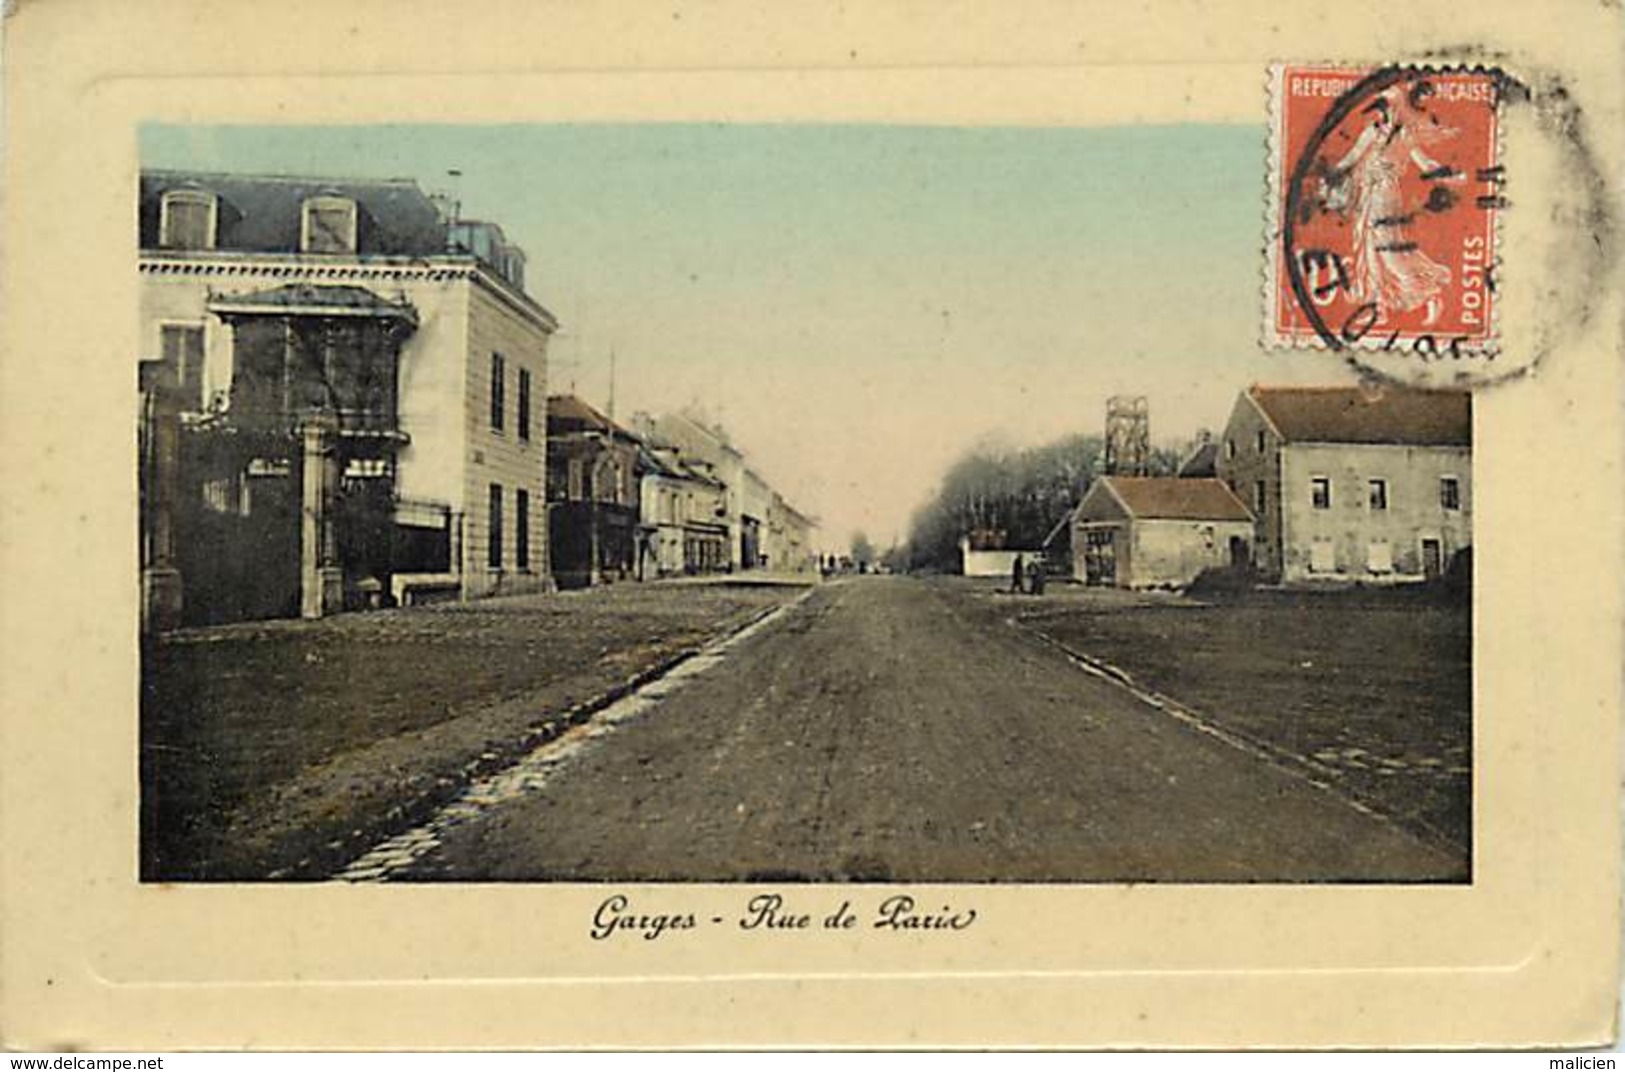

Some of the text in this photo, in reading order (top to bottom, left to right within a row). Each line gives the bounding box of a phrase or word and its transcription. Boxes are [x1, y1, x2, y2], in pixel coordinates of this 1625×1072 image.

[1461, 236, 1484, 324] POSTES
[590, 895, 696, 940] Garges
[739, 894, 811, 930] Rue
[823, 901, 856, 929] de
[873, 895, 977, 931] Paris
